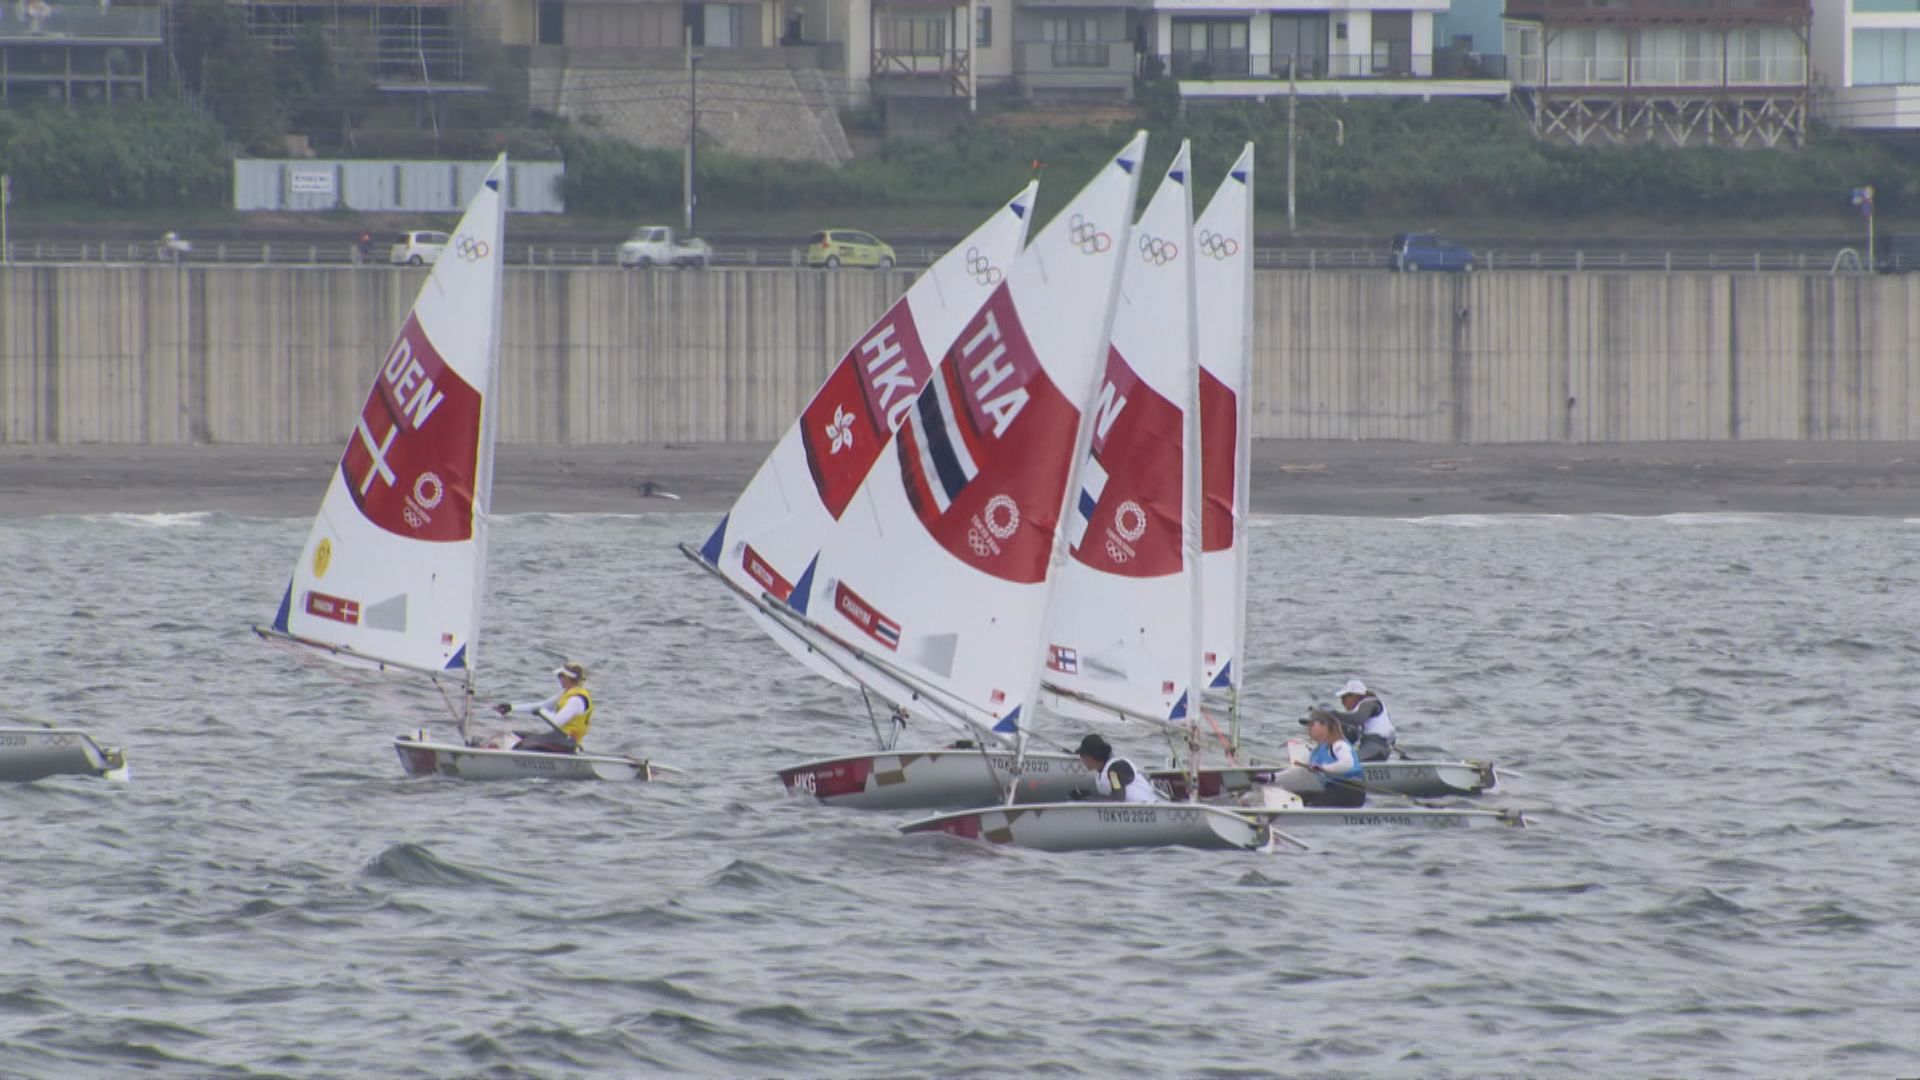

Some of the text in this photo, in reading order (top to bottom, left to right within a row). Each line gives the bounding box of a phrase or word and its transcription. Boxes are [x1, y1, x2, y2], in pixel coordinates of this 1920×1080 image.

[384, 337, 445, 430] DEN
[963, 310, 1030, 439] THA
[1097, 809, 1157, 824] TOKYO 2020
